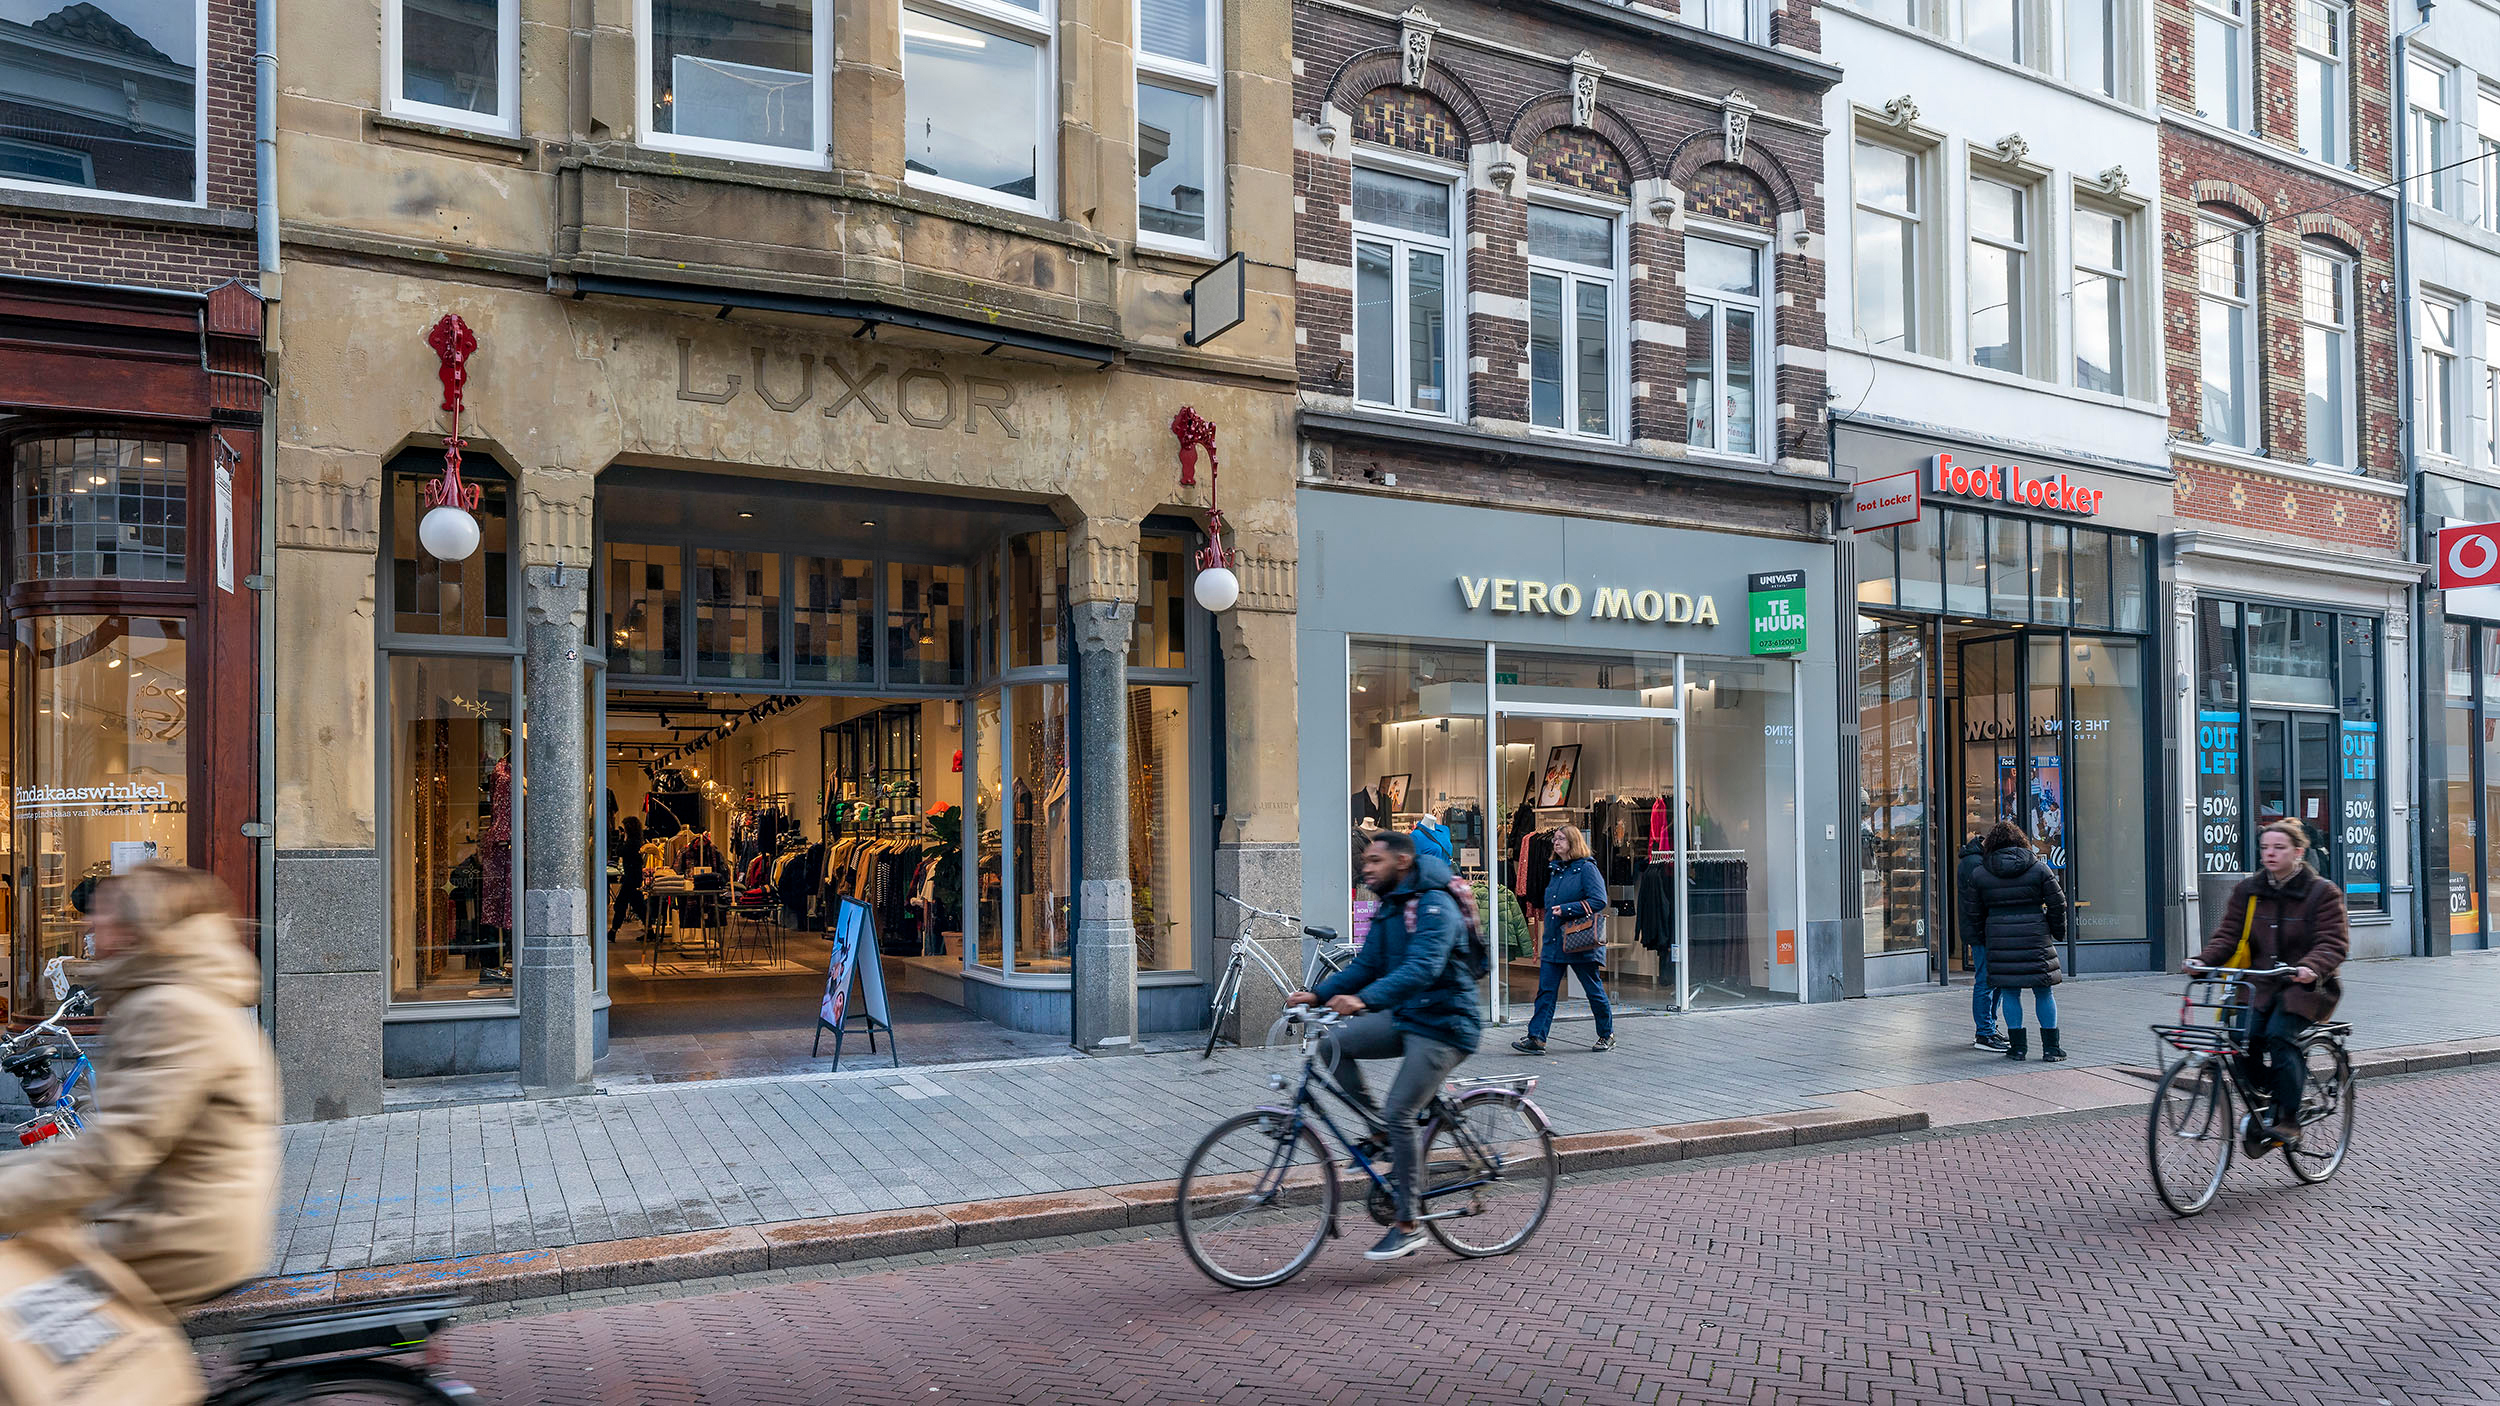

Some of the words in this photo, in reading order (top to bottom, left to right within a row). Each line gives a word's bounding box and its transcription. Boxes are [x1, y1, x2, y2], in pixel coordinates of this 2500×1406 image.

[676, 337, 1021, 439] LUXOR
[1935, 453, 2002, 500] Foot
[2009, 464, 2104, 515] Locker
[1856, 499, 1879, 513] Foot
[1879, 493, 1912, 508] Locker
[1760, 573, 1798, 585] UNIVAST
[1456, 575, 1582, 617] VERO
[1590, 586, 1720, 626] MODA
[1768, 599, 1789, 616] TE
[1755, 614, 1805, 633] HUUR
[1759, 638, 1802, 648] 073-6120013
[2199, 726, 2239, 750] OUT
[2343, 734, 2376, 757] OUT
[2200, 751, 2239, 775] LET
[2344, 757, 2376, 780] LET
[73, 810, 89, 818] van
[91, 807, 144, 817] Nederland
[2202, 796, 2237, 817] 50%
[2345, 800, 2375, 818] 50%
[2203, 824, 2238, 844] 60%
[2346, 826, 2376, 845] 60%
[2204, 852, 2239, 872] 70%
[2346, 851, 2377, 870] 70%
